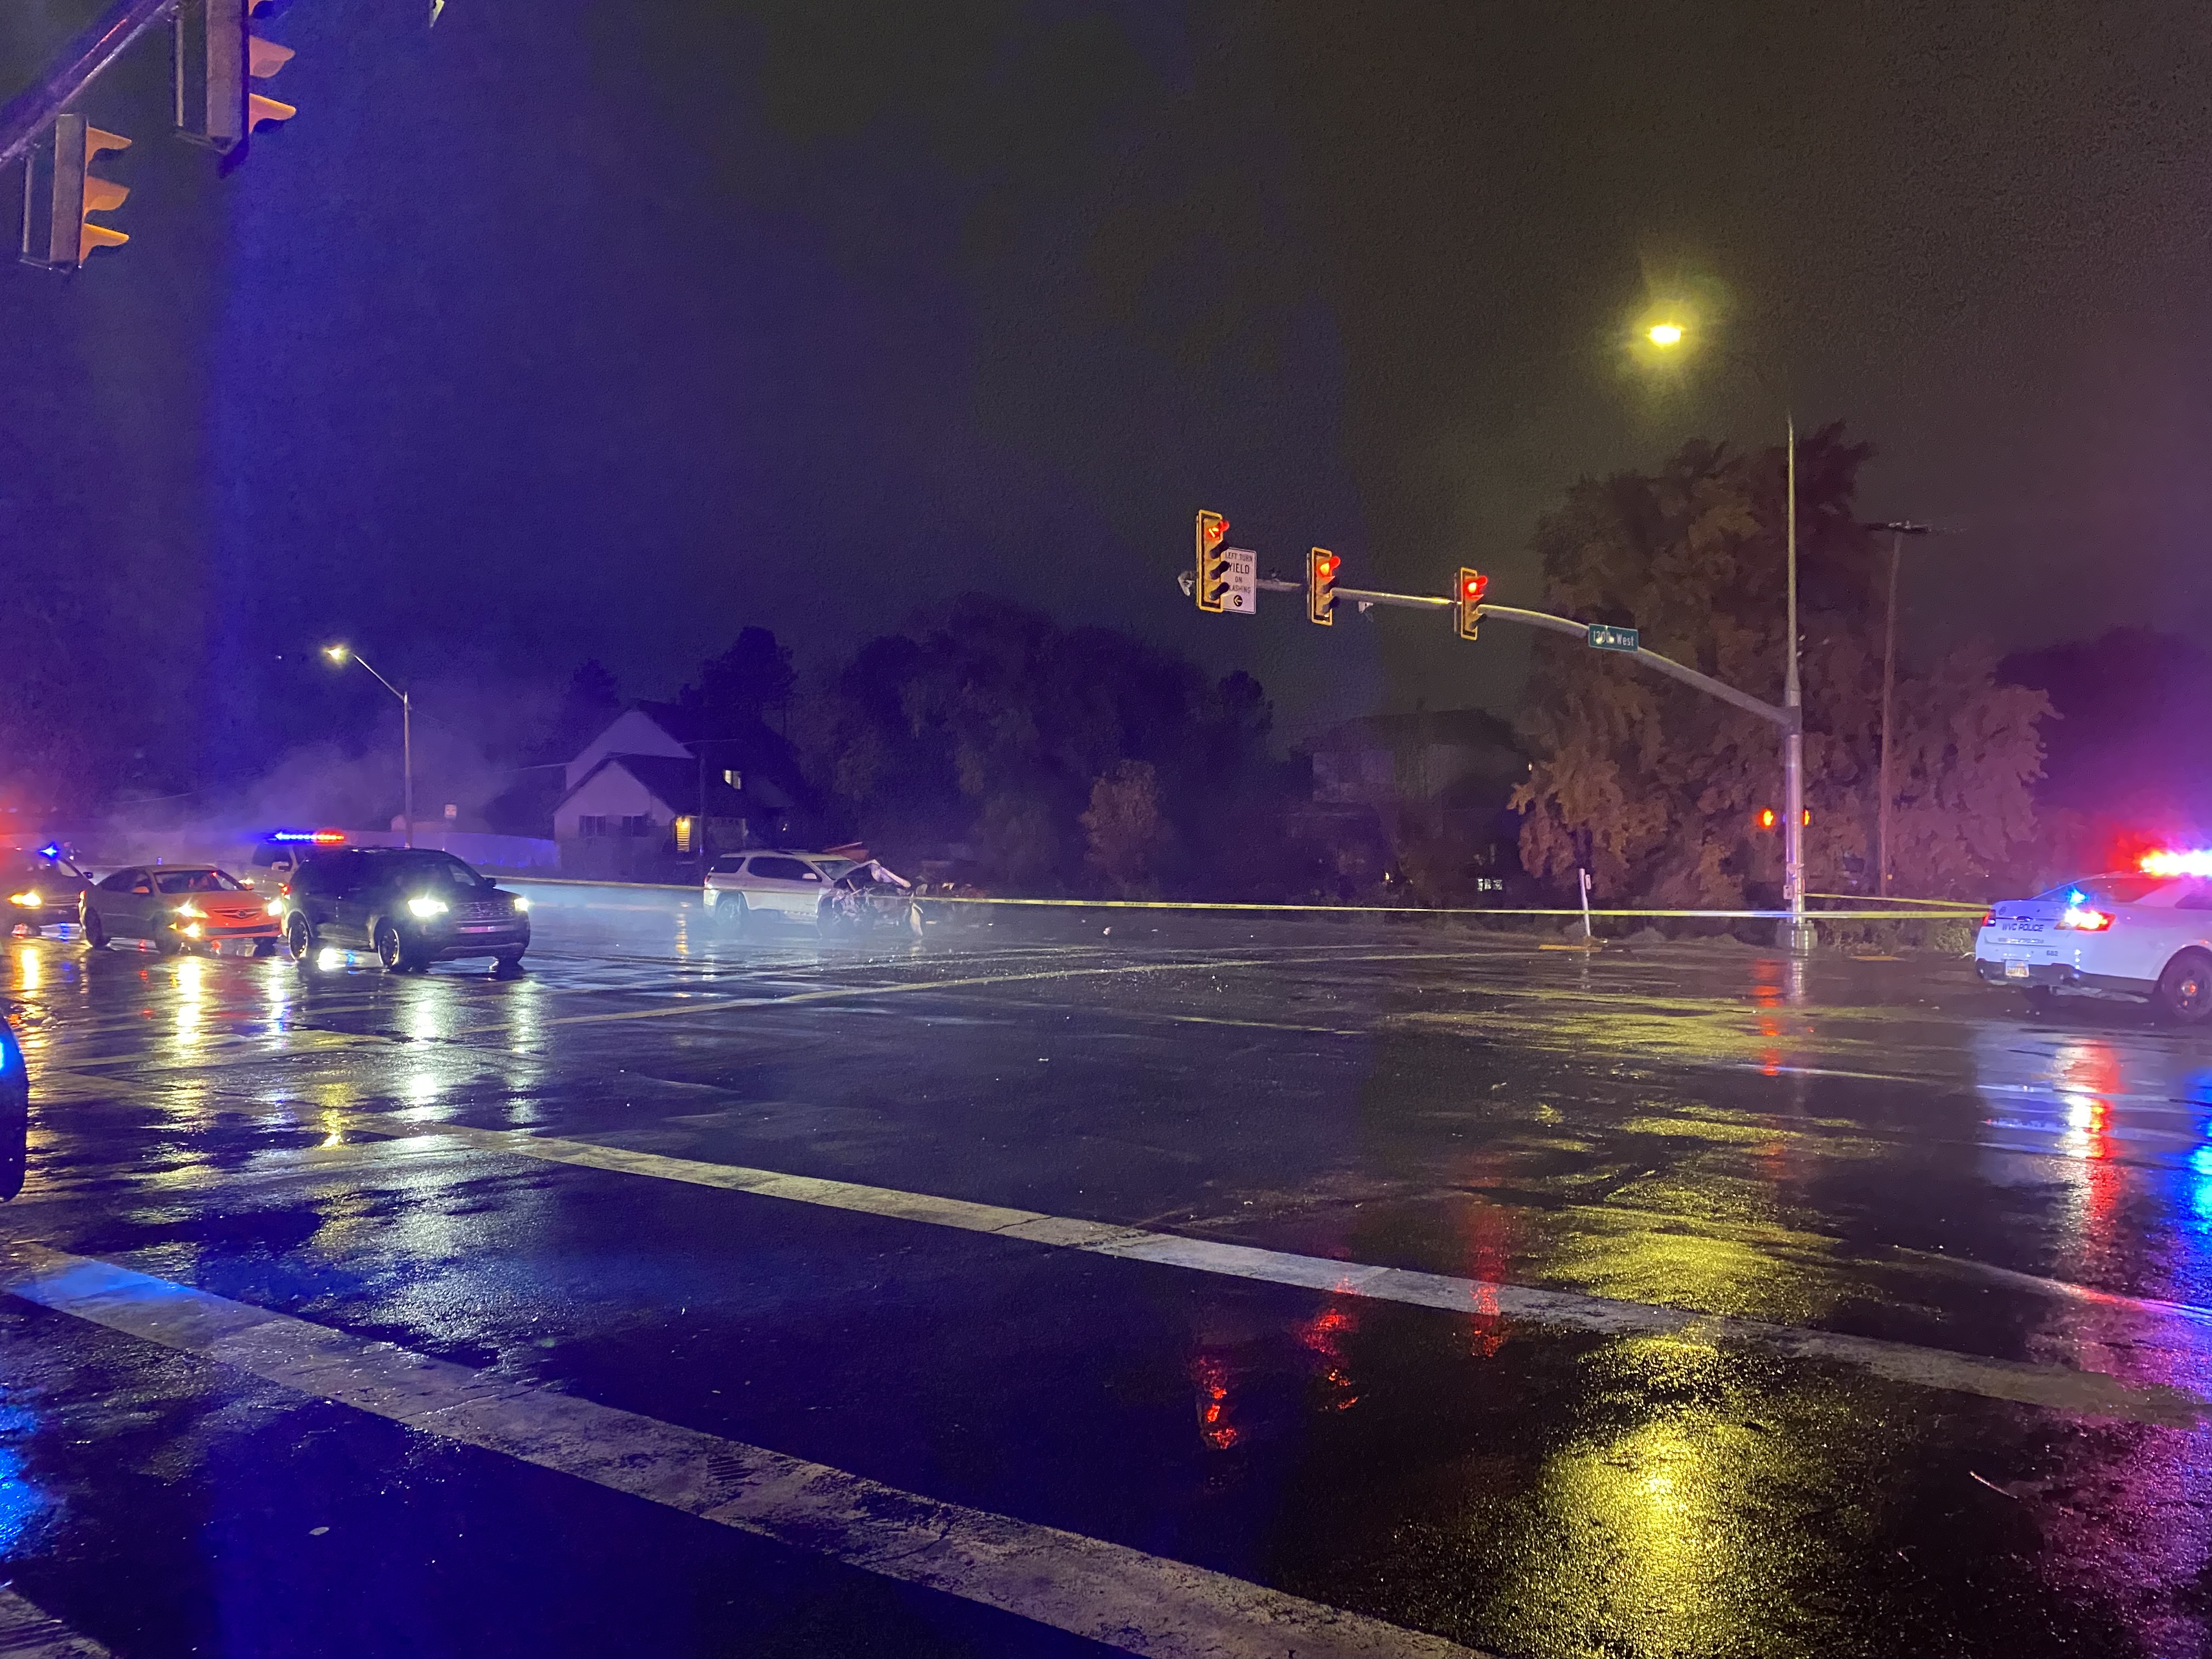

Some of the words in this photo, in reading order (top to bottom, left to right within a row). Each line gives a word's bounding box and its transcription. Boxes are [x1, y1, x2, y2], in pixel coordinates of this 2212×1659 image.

[1225, 551, 1237, 560] LEFT
[1239, 554, 1253, 562] TURN
[1228, 563, 1250, 574] YIELD
[1616, 633, 1634, 646] West
[2018, 923, 2044, 932] POLICE
